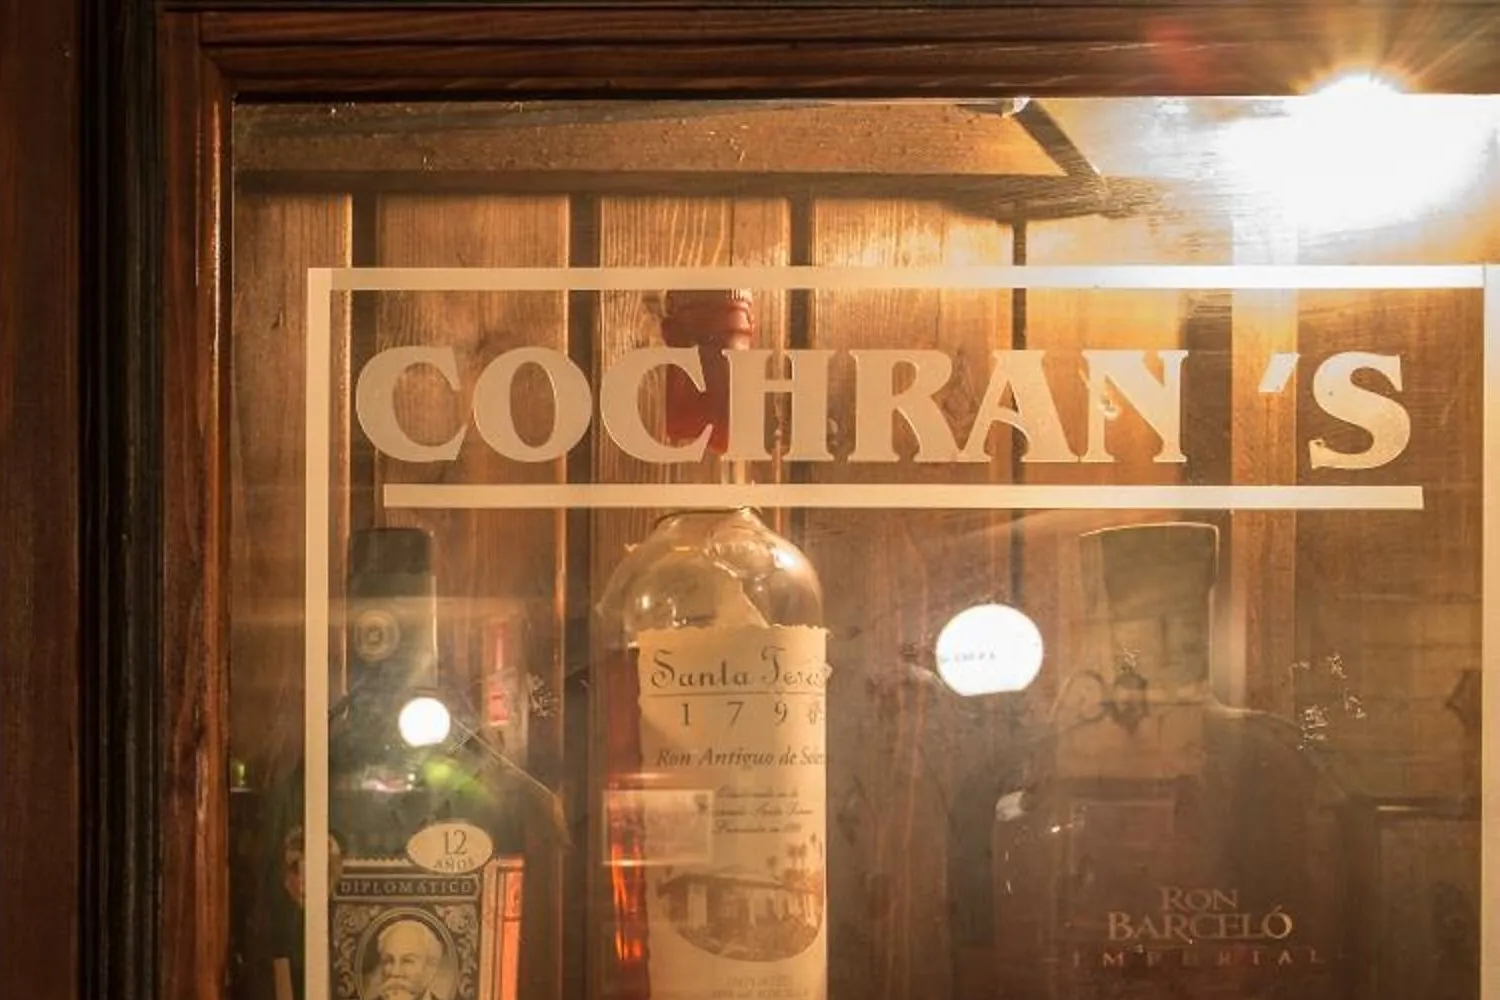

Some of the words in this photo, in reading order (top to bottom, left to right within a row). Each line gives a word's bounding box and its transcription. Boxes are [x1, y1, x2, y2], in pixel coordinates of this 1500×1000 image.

[355, 345, 1188, 463] COCHRAN
[651, 649, 749, 688] Santa
[656, 748, 691, 767] Ron
[444, 829, 468, 855] 12
[1159, 885, 1239, 912] RON
[1107, 904, 1293, 944] BARCELÓ
